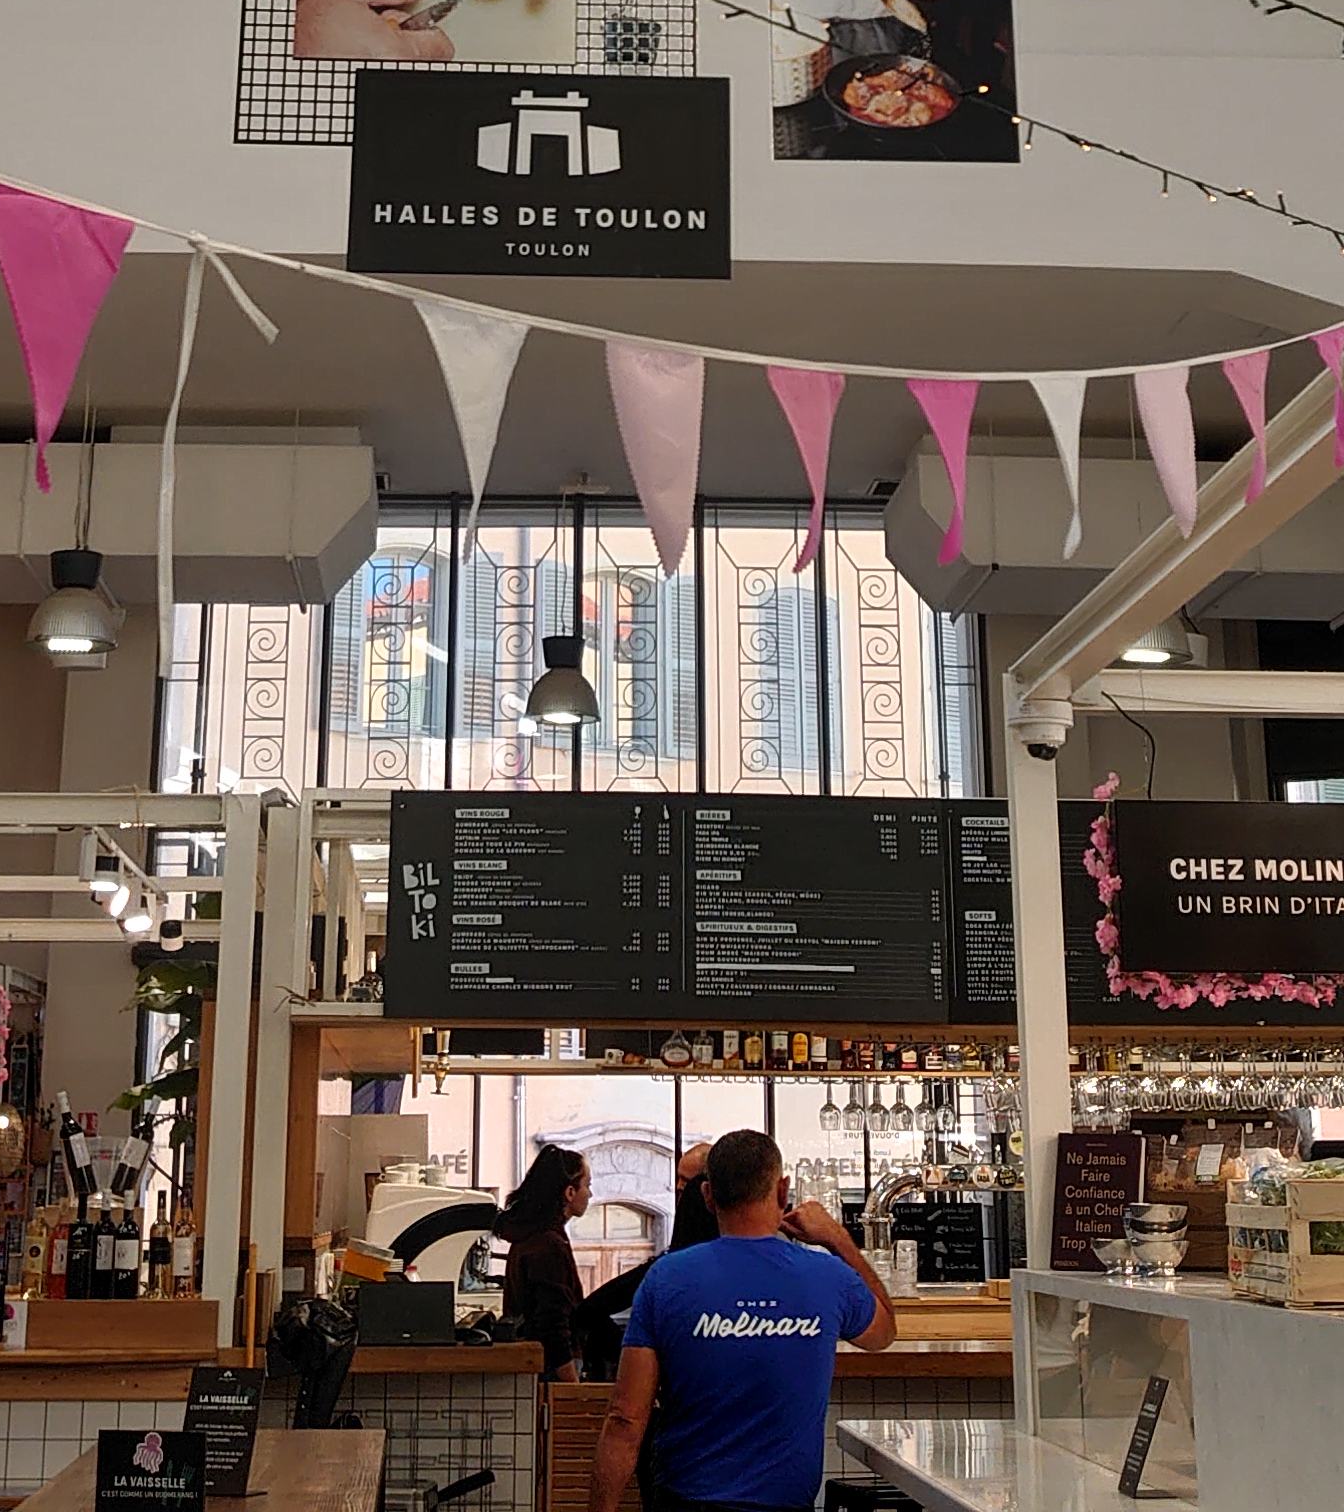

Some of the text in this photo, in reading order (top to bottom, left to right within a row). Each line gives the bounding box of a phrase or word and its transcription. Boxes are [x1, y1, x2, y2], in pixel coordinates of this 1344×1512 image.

[374, 204, 706, 230] HALLES DE TOULON
[505, 242, 590, 257] TOULON
[700, 811, 726, 819] BIÈRES
[873, 814, 938, 823] DEMI PINTE
[700, 871, 738, 879] APÉRITIFS
[1169, 857, 1244, 882] CHEZ
[1177, 895, 1212, 914] UN
[1222, 896, 1280, 915] BRIN
[756, 924, 794, 932] DIGESTIFS
[1066, 1152, 1127, 1166] Ne Jamais
[1081, 1169, 1111, 1182] Faire
[1065, 1185, 1126, 1199] Confiance
[1065, 1203, 1124, 1216] à un Chef
[1075, 1219, 1112, 1233] Italien
[1060, 1235, 1087, 1252] Trop
[736, 1299, 778, 1307] CHEZ
[692, 1311, 822, 1339] Molinari
[199, 1394, 249, 1405] LA VAISSELLE
[114, 1475, 186, 1488] LA VAISSELLE
